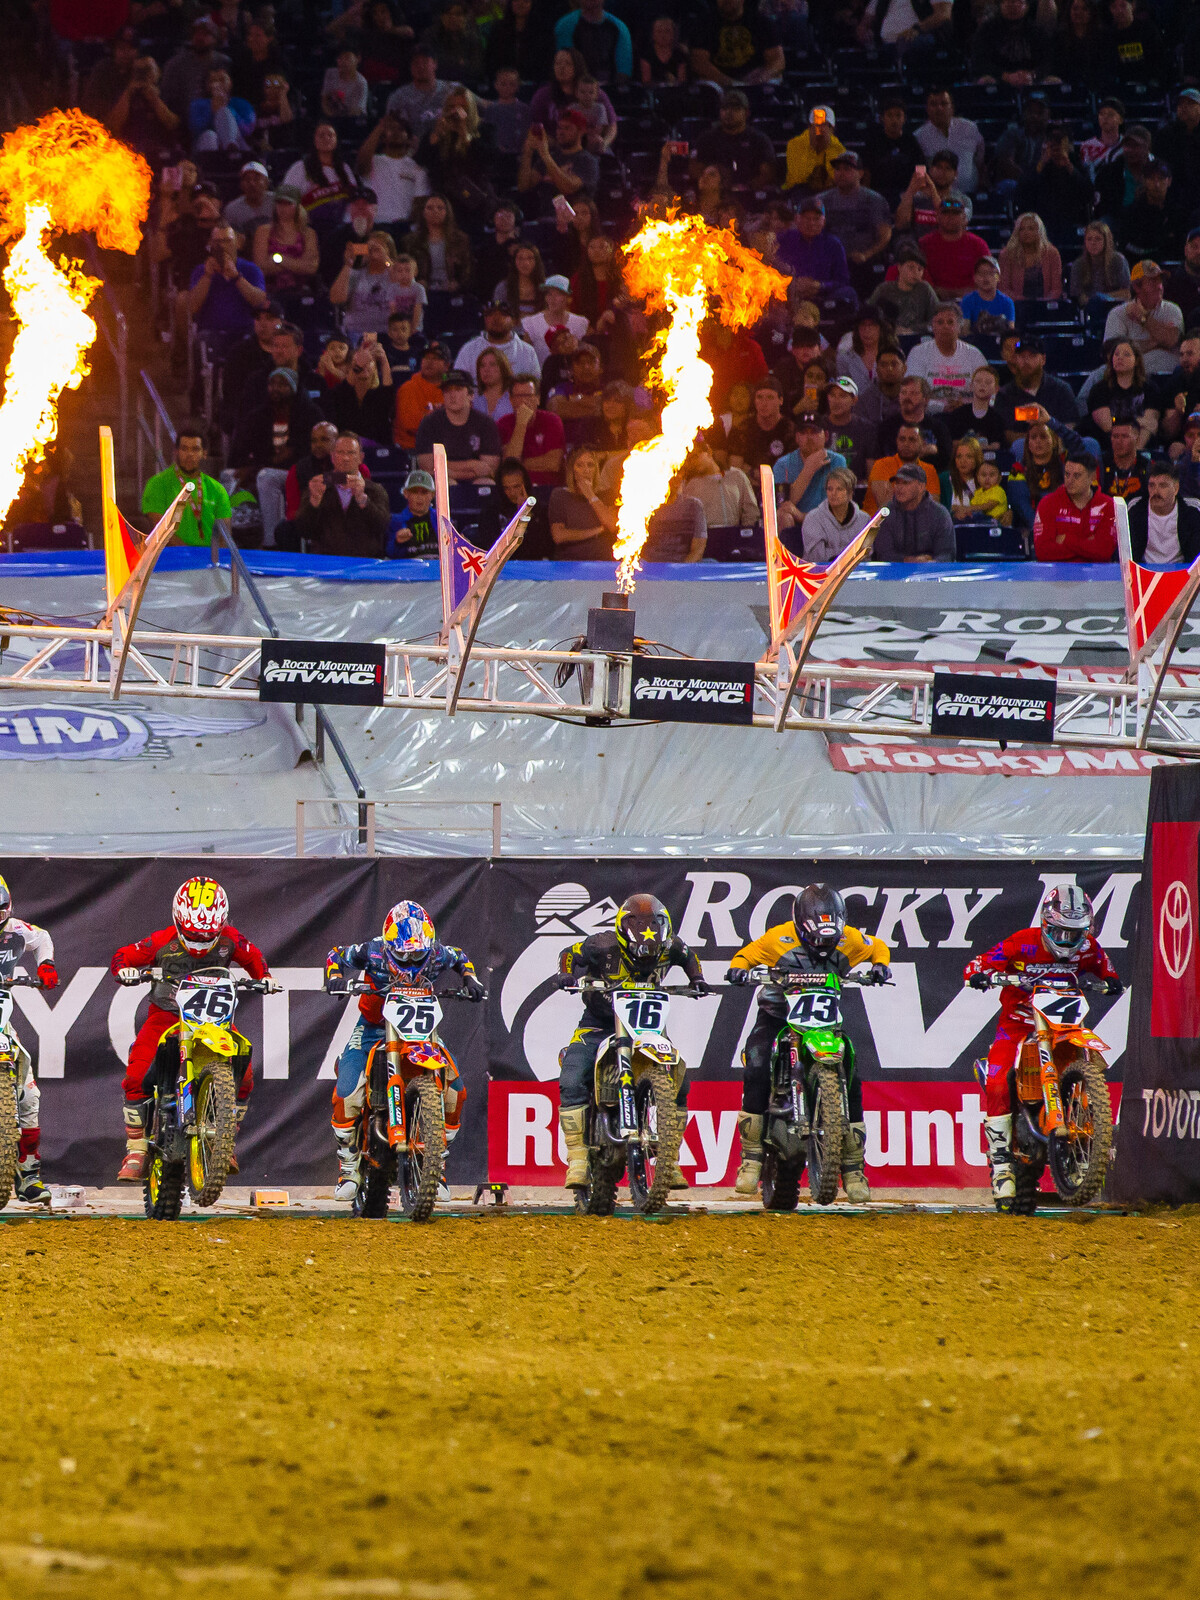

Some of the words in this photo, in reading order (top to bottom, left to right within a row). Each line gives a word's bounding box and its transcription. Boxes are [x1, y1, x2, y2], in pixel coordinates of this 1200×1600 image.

[281, 659, 317, 670] ROCKY
[318, 660, 375, 673] MOUNTAIN
[651, 677, 687, 687] ROCKY
[688, 678, 745, 691] MOUNTAIN
[954, 693, 988, 704] ROCKY
[988, 695, 1046, 708] MOUNTAIN
[842, 746, 1200, 774] RockyMo
[188, 881, 217, 908] 46
[678, 872, 1002, 948] ROCKY
[1021, 944, 1039, 956] FLY
[183, 990, 233, 1018] 46
[625, 1001, 662, 1029] 16
[789, 995, 837, 1023] 43
[1041, 997, 1081, 1024] 4
[397, 1005, 434, 1034] 25
[1142, 1088, 1200, 1139] TOYOT
